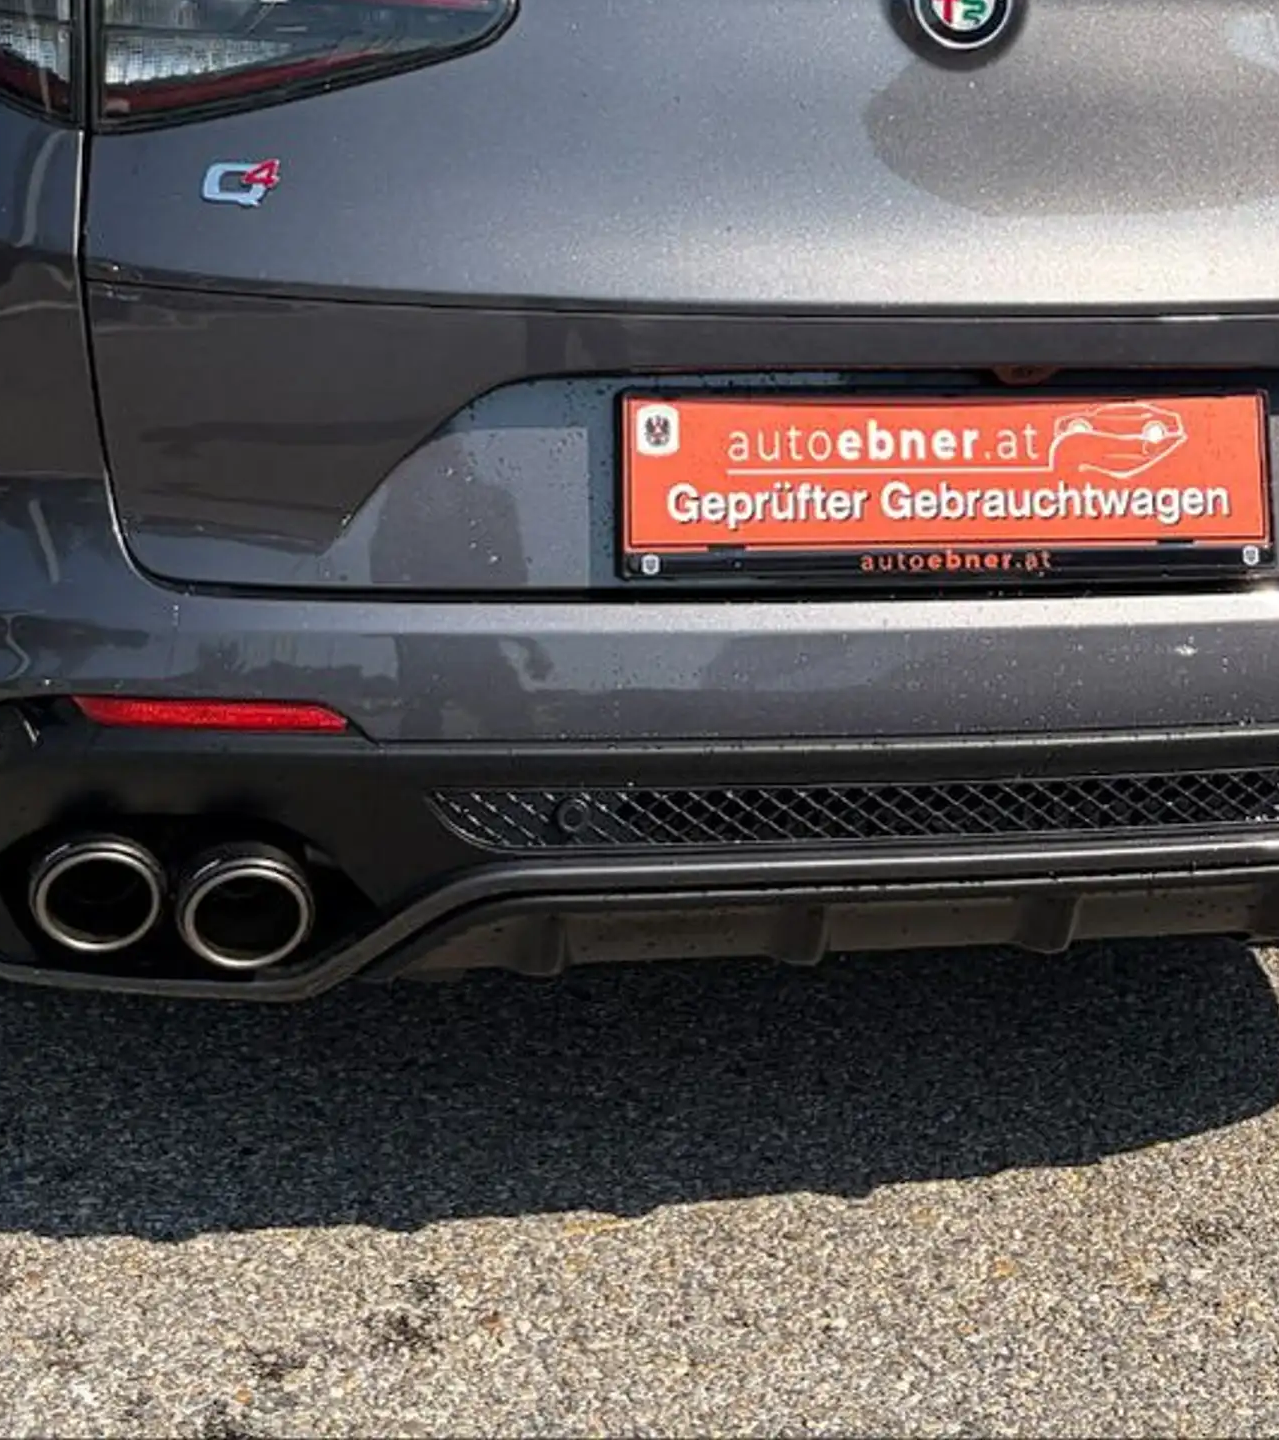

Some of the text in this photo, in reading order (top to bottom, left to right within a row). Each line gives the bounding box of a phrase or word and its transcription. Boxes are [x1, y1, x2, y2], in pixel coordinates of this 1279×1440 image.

[202, 159, 280, 207] Q4
[727, 419, 1039, 460] autoebner.at
[667, 480, 1228, 530] Geprüfter Gebrauchtwagen
[859, 549, 1052, 572] autoebner.at
